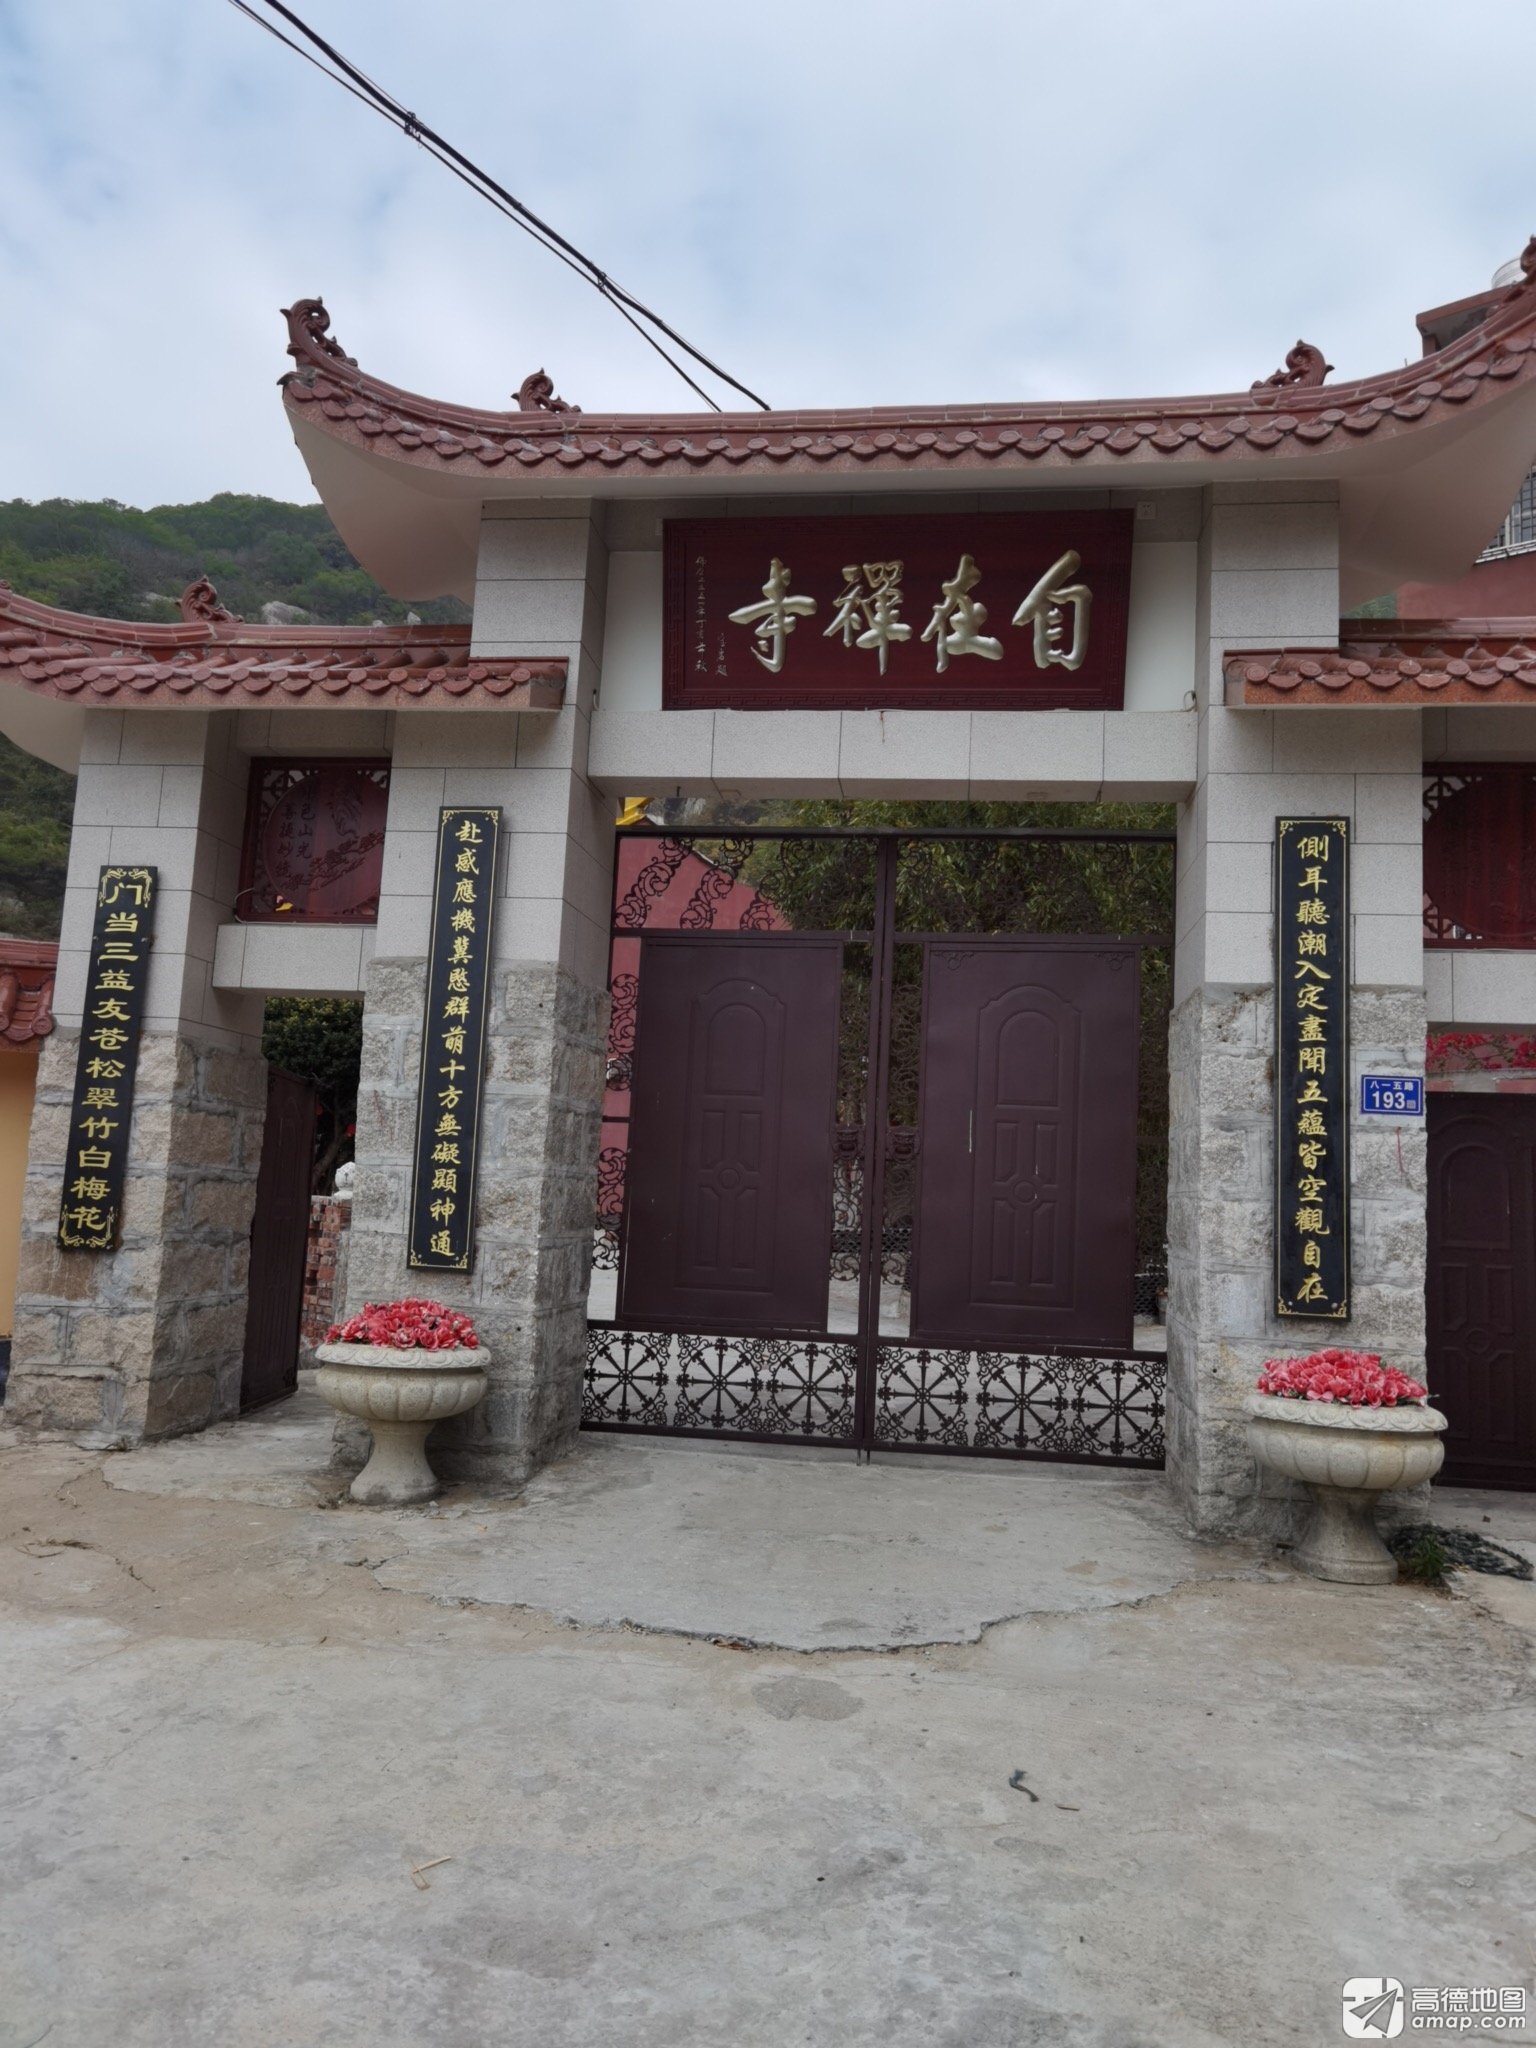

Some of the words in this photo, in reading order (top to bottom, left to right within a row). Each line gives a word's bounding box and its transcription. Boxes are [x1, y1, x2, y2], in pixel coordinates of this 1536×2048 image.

[1370, 1080, 1414, 1091] 八一五路
[1372, 1091, 1405, 1109] 193
